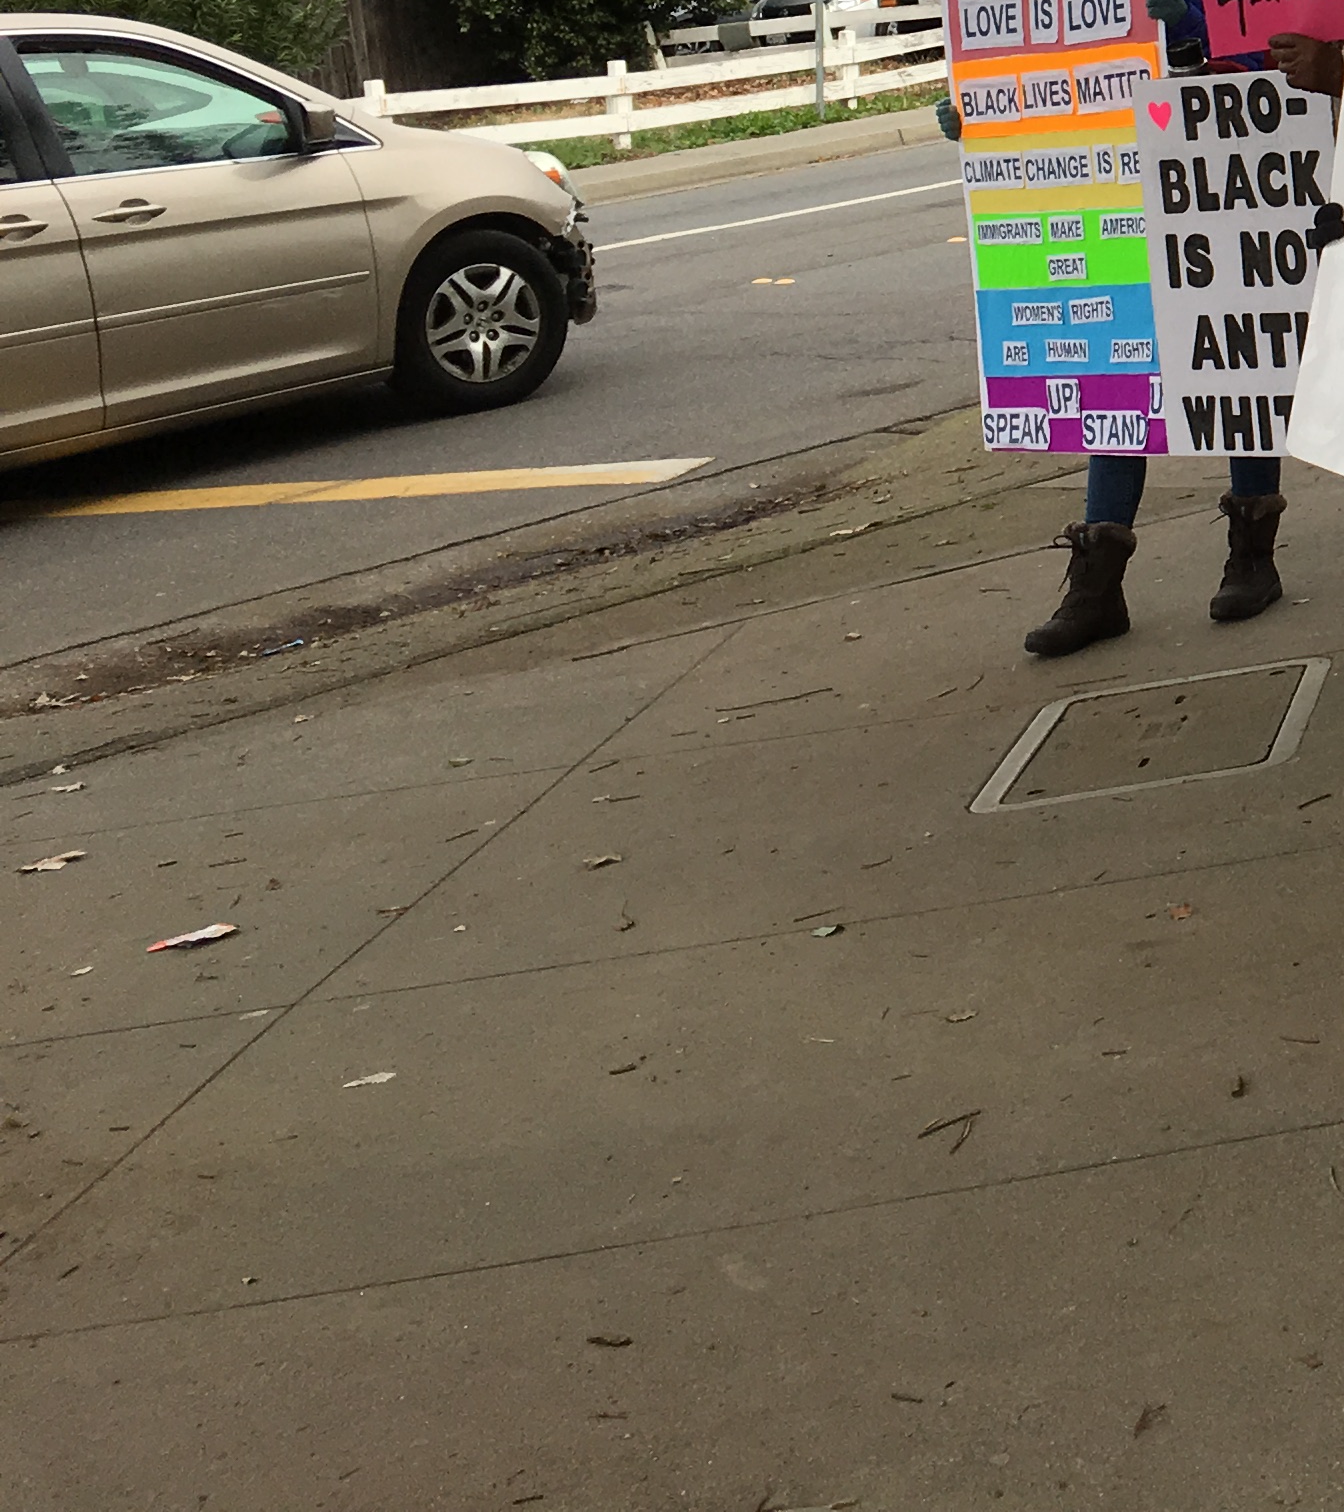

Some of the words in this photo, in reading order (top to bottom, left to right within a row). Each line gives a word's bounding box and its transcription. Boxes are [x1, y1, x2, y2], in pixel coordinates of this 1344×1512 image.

[963, 3, 1018, 38] LOVE
[961, 87, 1020, 118] BLACK
[1022, 79, 1072, 109] LIVES
[1180, 78, 1307, 141] PRO-
[964, 158, 1022, 183] CLIMATE
[1025, 155, 1089, 181] CHANGE
[1097, 151, 1113, 174] IS
[1120, 151, 1140, 175] RE
[1159, 150, 1325, 214] BLACK
[977, 221, 1042, 240] IMMIGRANTS
[1050, 220, 1082, 238] MAKE
[1102, 217, 1146, 235] AMERIC
[1048, 257, 1084, 276] GREAT
[1165, 233, 1214, 288] IS
[1014, 305, 1063, 322] WOMEN'S
[1071, 301, 1112, 320] RIGHTS
[1006, 345, 1028, 362] ARE
[1047, 341, 1087, 359] HUMAN
[1112, 341, 1151, 358] RIGHTS
[984, 413, 1048, 445] SPEAK
[1048, 382, 1079, 414] UP!
[1083, 413, 1148, 446] STAND
